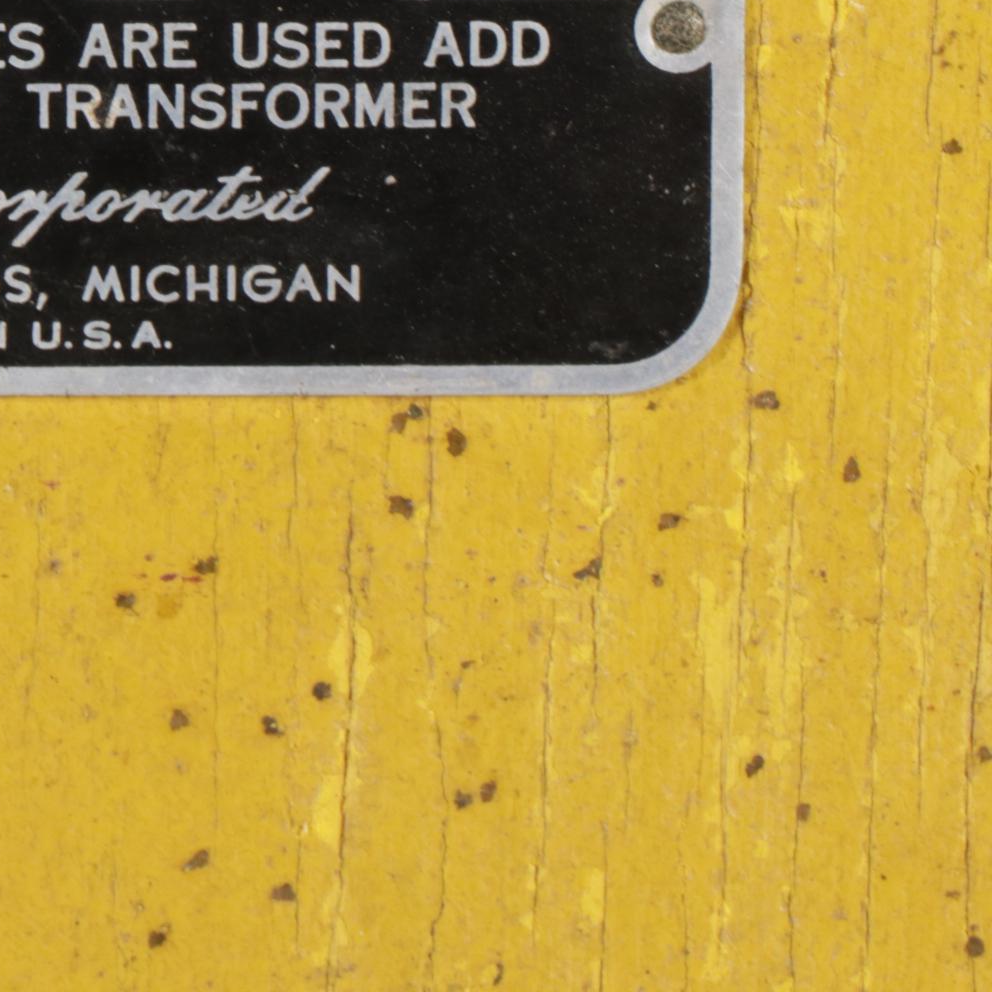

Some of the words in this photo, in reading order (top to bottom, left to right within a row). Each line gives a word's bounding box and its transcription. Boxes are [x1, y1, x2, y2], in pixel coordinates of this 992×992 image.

[78, 21, 198, 68] ARE
[232, 20, 391, 68] USED
[423, 20, 551, 68] ADD
[26, 81, 478, 130] TRANSFORMER
[81, 263, 362, 304] MICHIGAN
